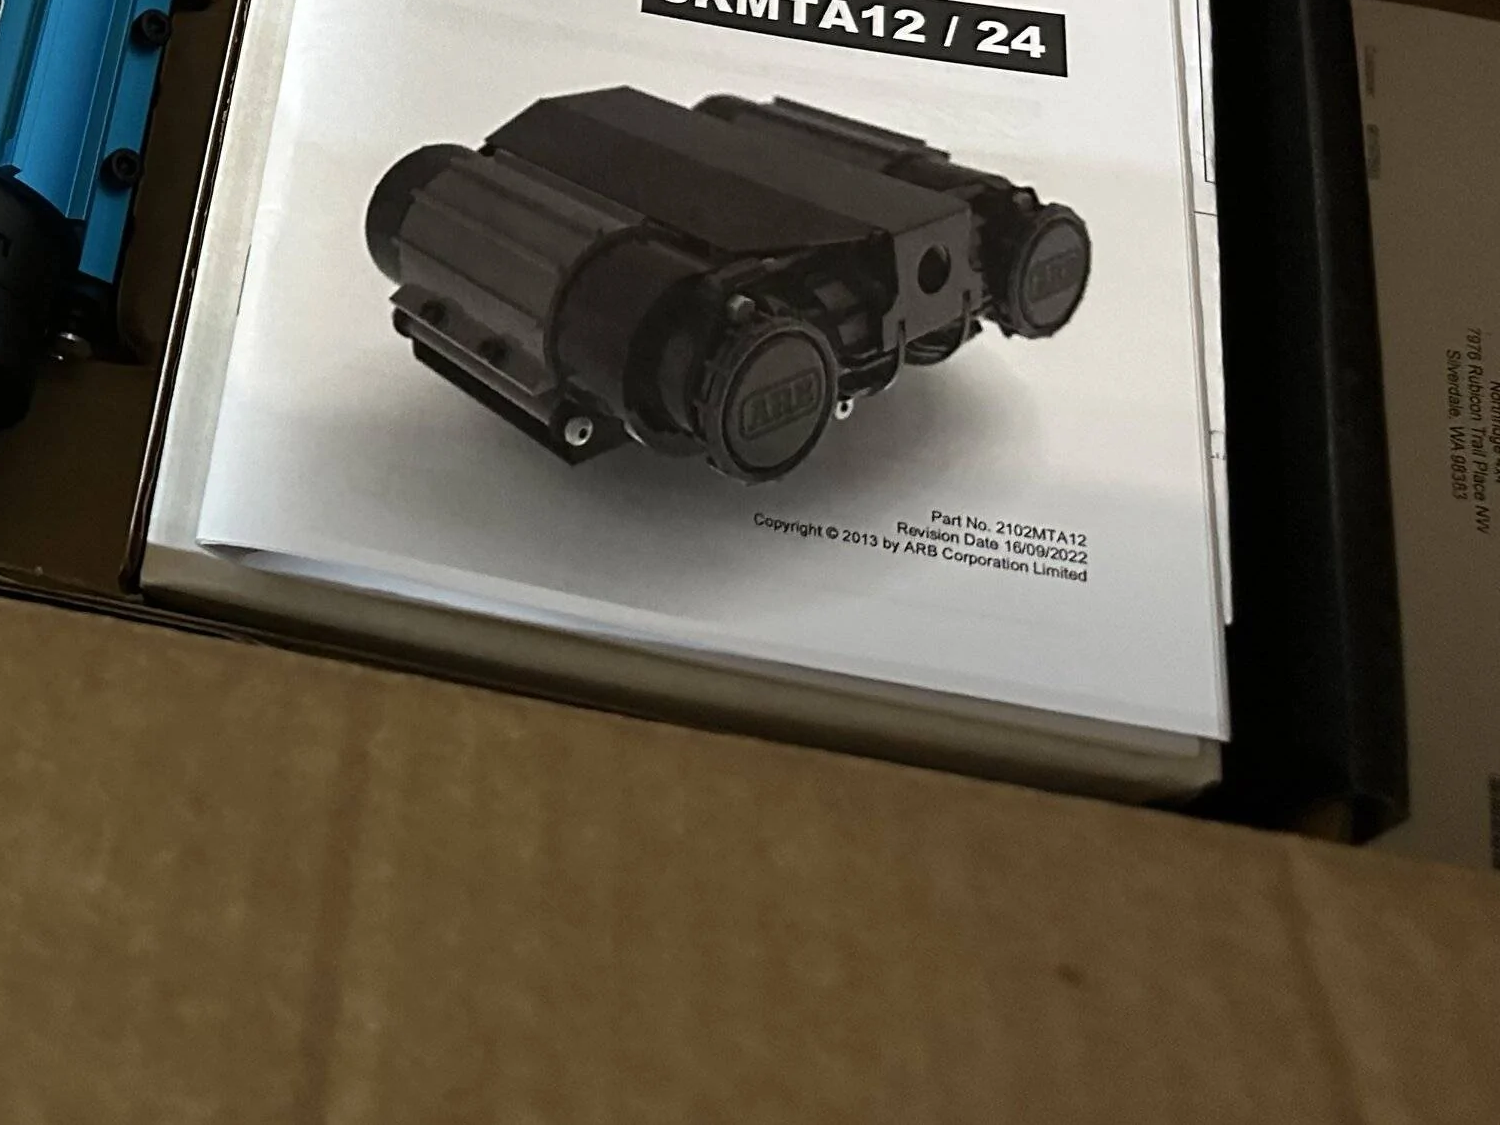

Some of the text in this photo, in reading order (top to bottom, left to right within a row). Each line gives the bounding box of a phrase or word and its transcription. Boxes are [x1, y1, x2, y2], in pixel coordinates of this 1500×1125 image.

[943, 13, 959, 48] /
[976, 20, 1045, 59] 24
[1467, 365, 1484, 421] Rubicon
[1449, 426, 1465, 451] WA
[1471, 427, 1487, 457] Trail
[1473, 460, 1488, 500] Place
[931, 510, 1087, 547] Part No. 2102MTA12
[1475, 505, 1491, 535] NW
[754, 512, 822, 537] Copyright
[842, 530, 877, 547] 2013
[883, 537, 900, 553] by
[904, 541, 938, 557] ARB
[942, 547, 1029, 573] Corporation
[1033, 562, 1087, 583] Limited
[897, 521, 1088, 564] Revision Date 16/09/2022
